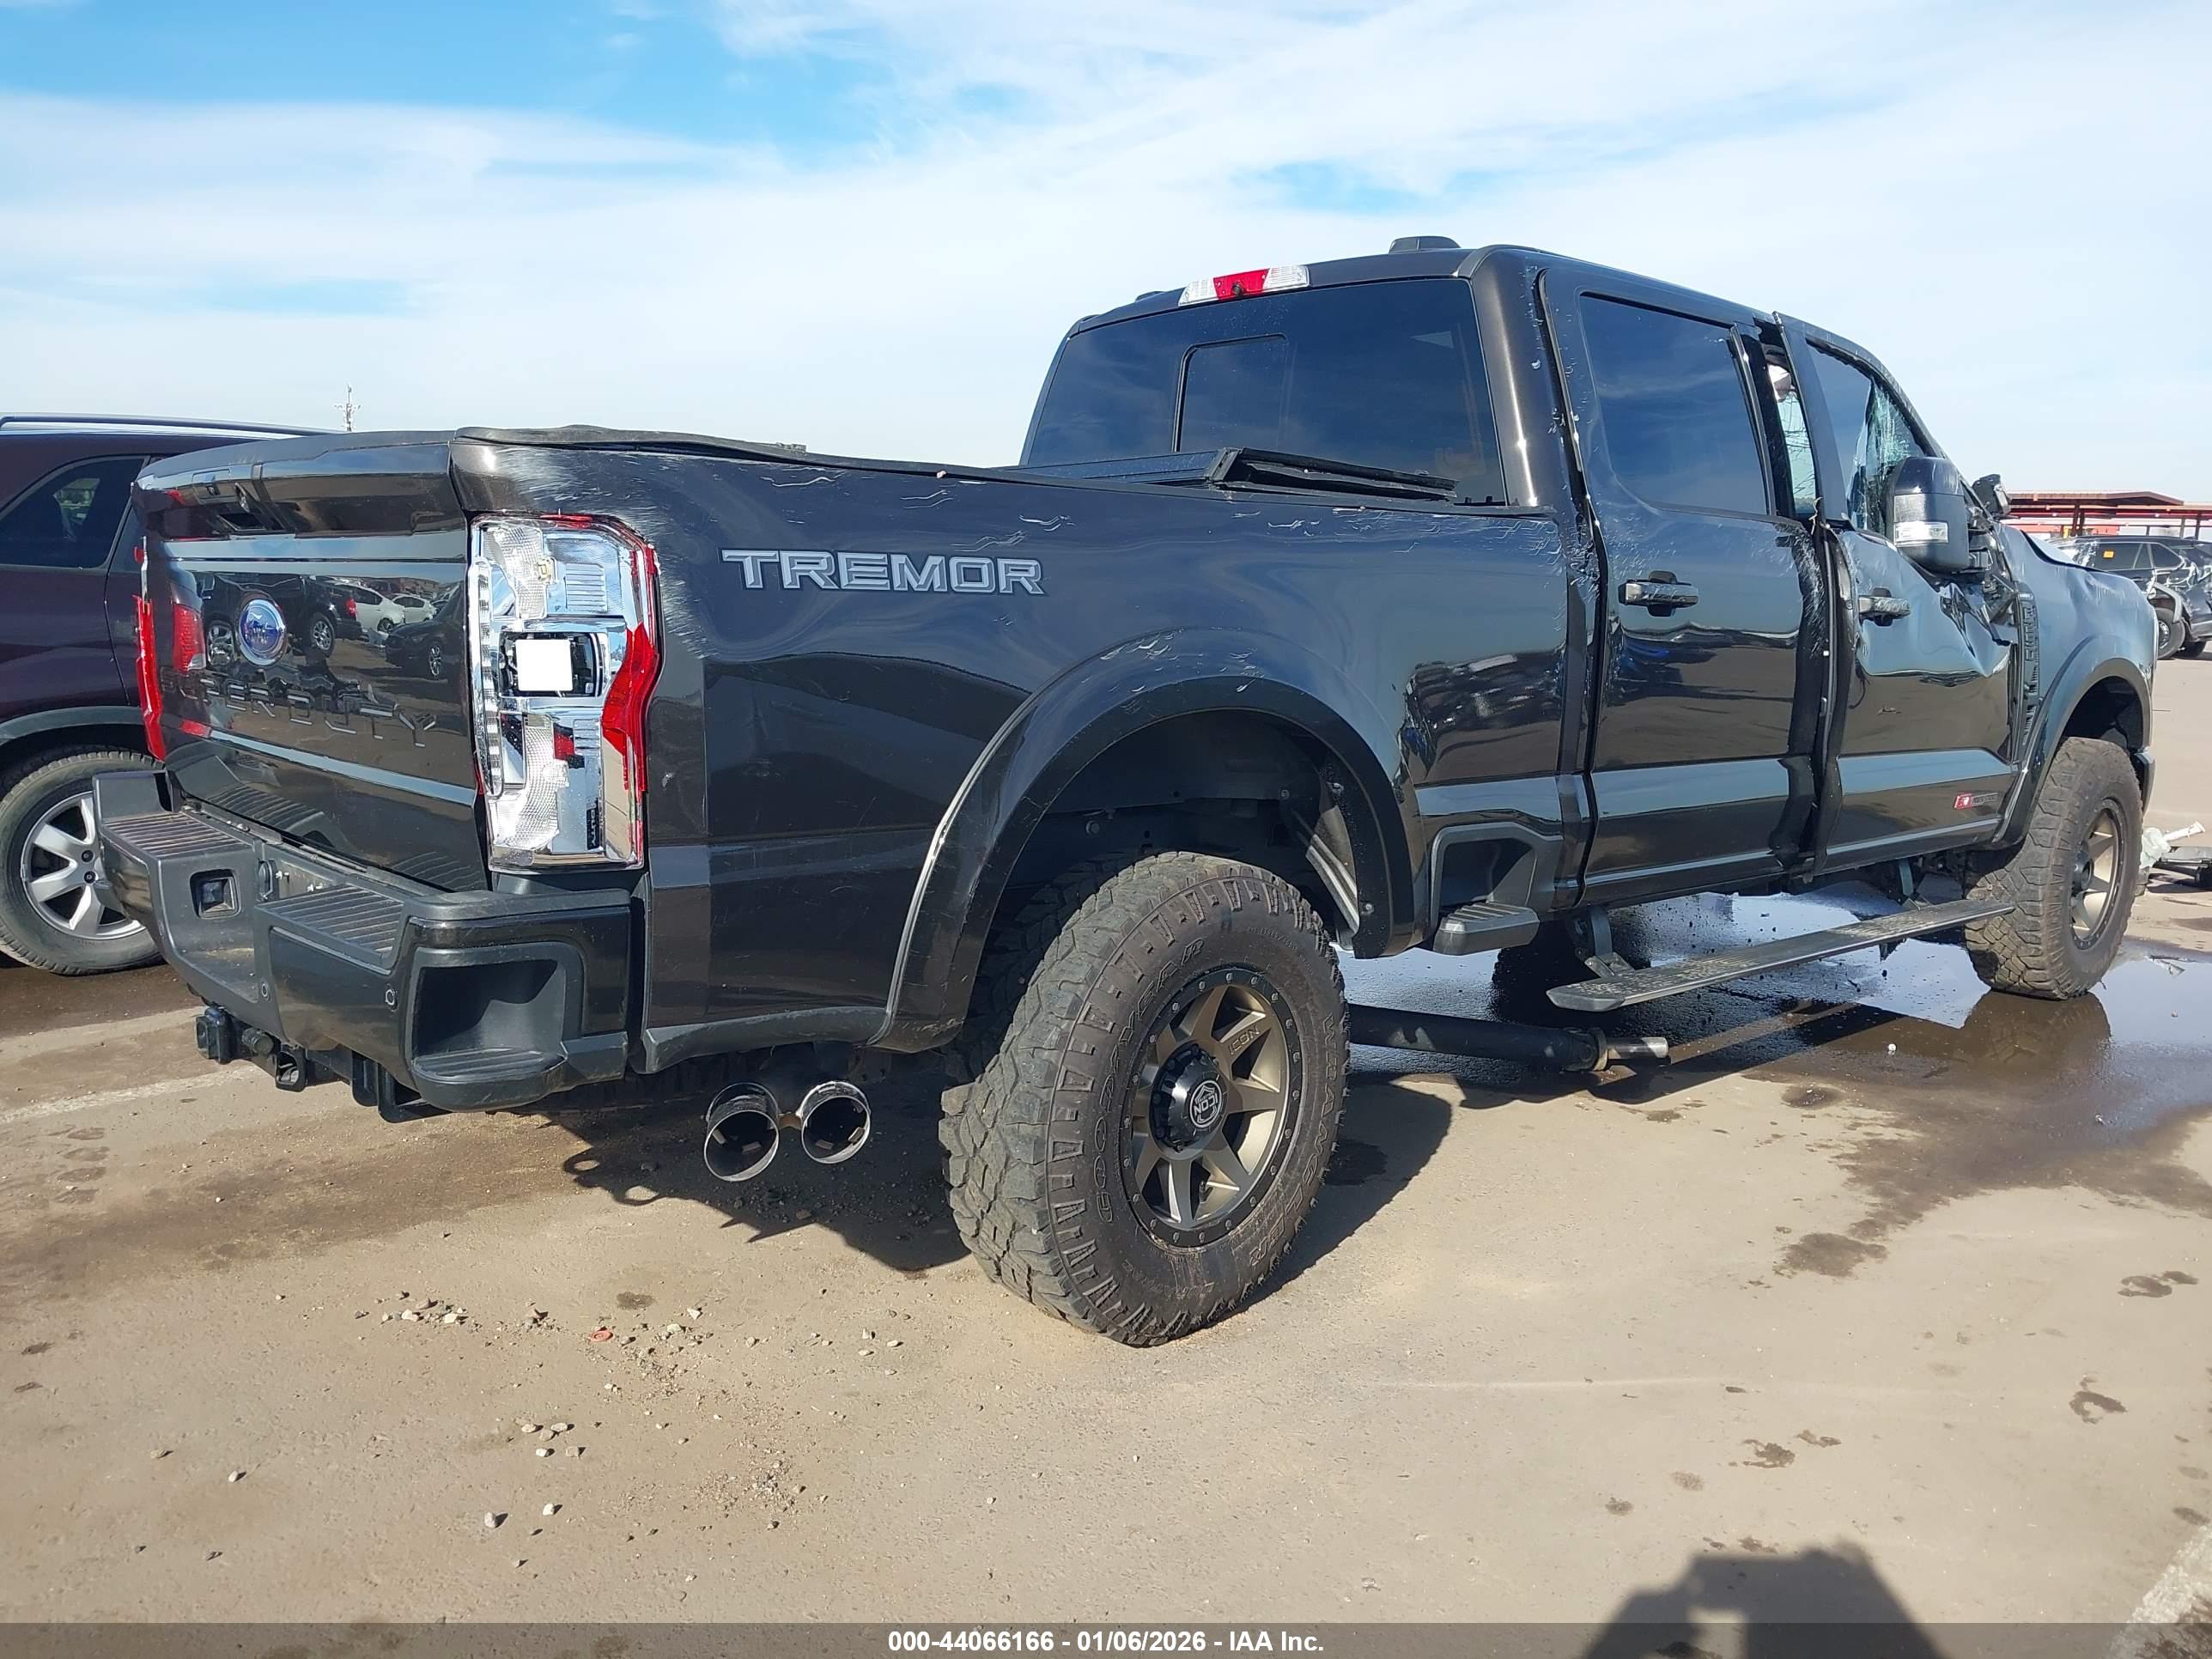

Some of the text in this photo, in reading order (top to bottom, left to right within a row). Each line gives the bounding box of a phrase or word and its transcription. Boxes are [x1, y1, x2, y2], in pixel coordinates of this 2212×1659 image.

[720, 548, 1046, 595] TREMOR
[161, 665, 437, 748] SUPER DUTY
[1229, 1024, 1261, 1055] ICON
[1094, 937, 1206, 1223] GOODYEAR
[1194, 1092, 1218, 1116] ICON
[1249, 1012, 1337, 1267] WRANGLER
